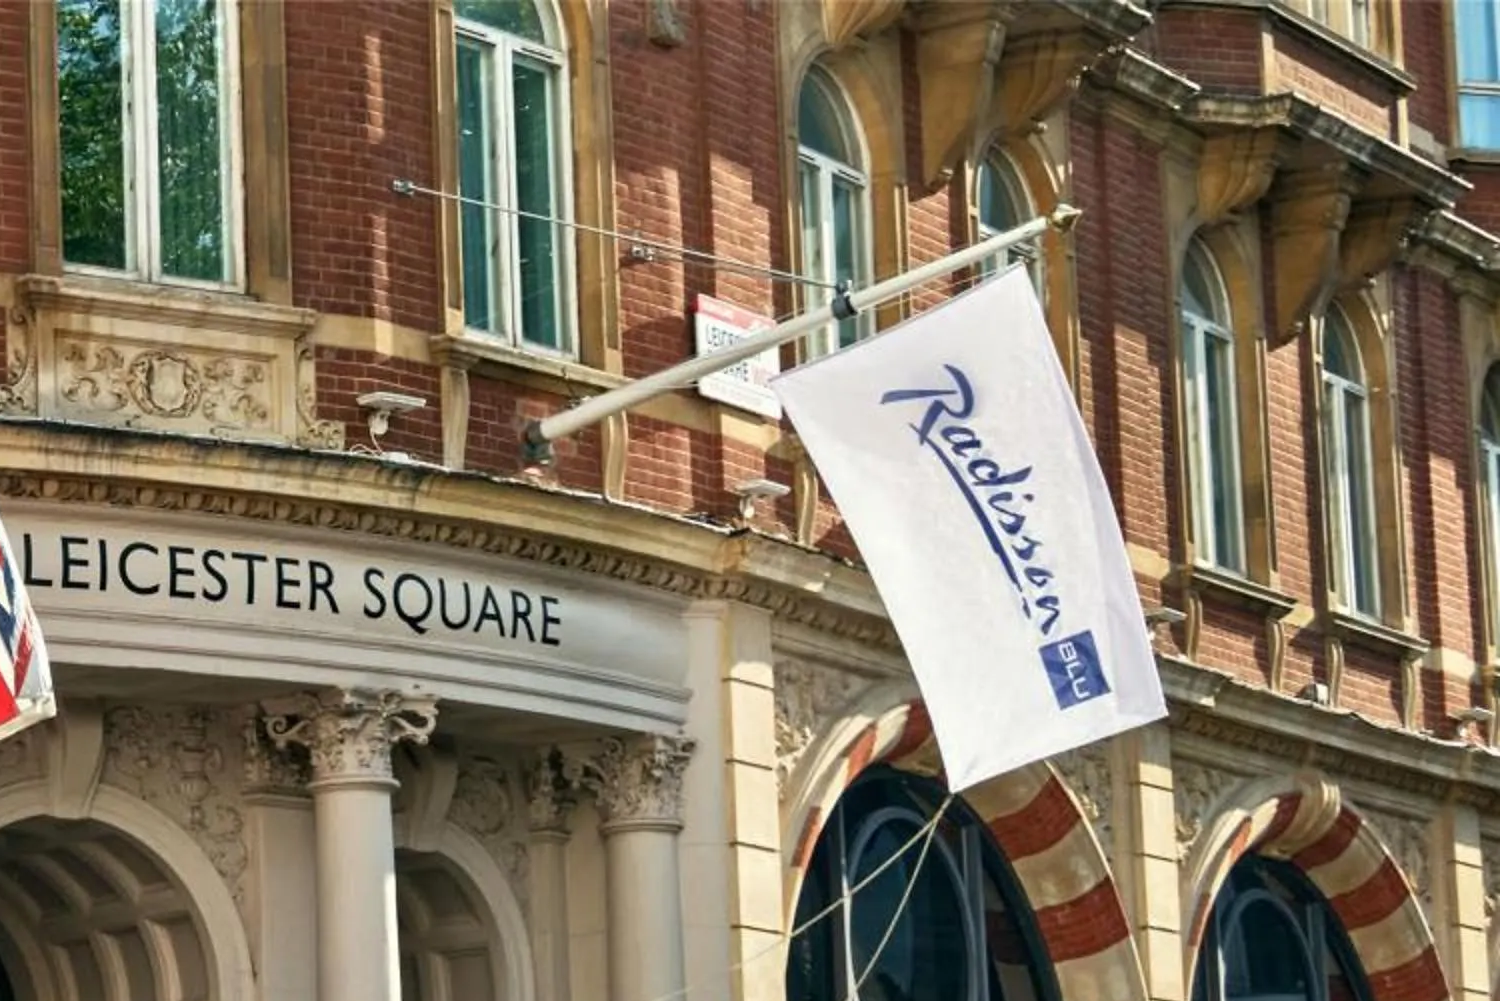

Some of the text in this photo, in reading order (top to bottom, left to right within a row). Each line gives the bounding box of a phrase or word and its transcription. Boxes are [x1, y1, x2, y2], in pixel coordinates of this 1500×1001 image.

[880, 363, 1062, 637] Radisson
[23, 533, 340, 615] LEICESTER
[363, 567, 562, 648] SQUARE
[1058, 641, 1091, 700] BLU
